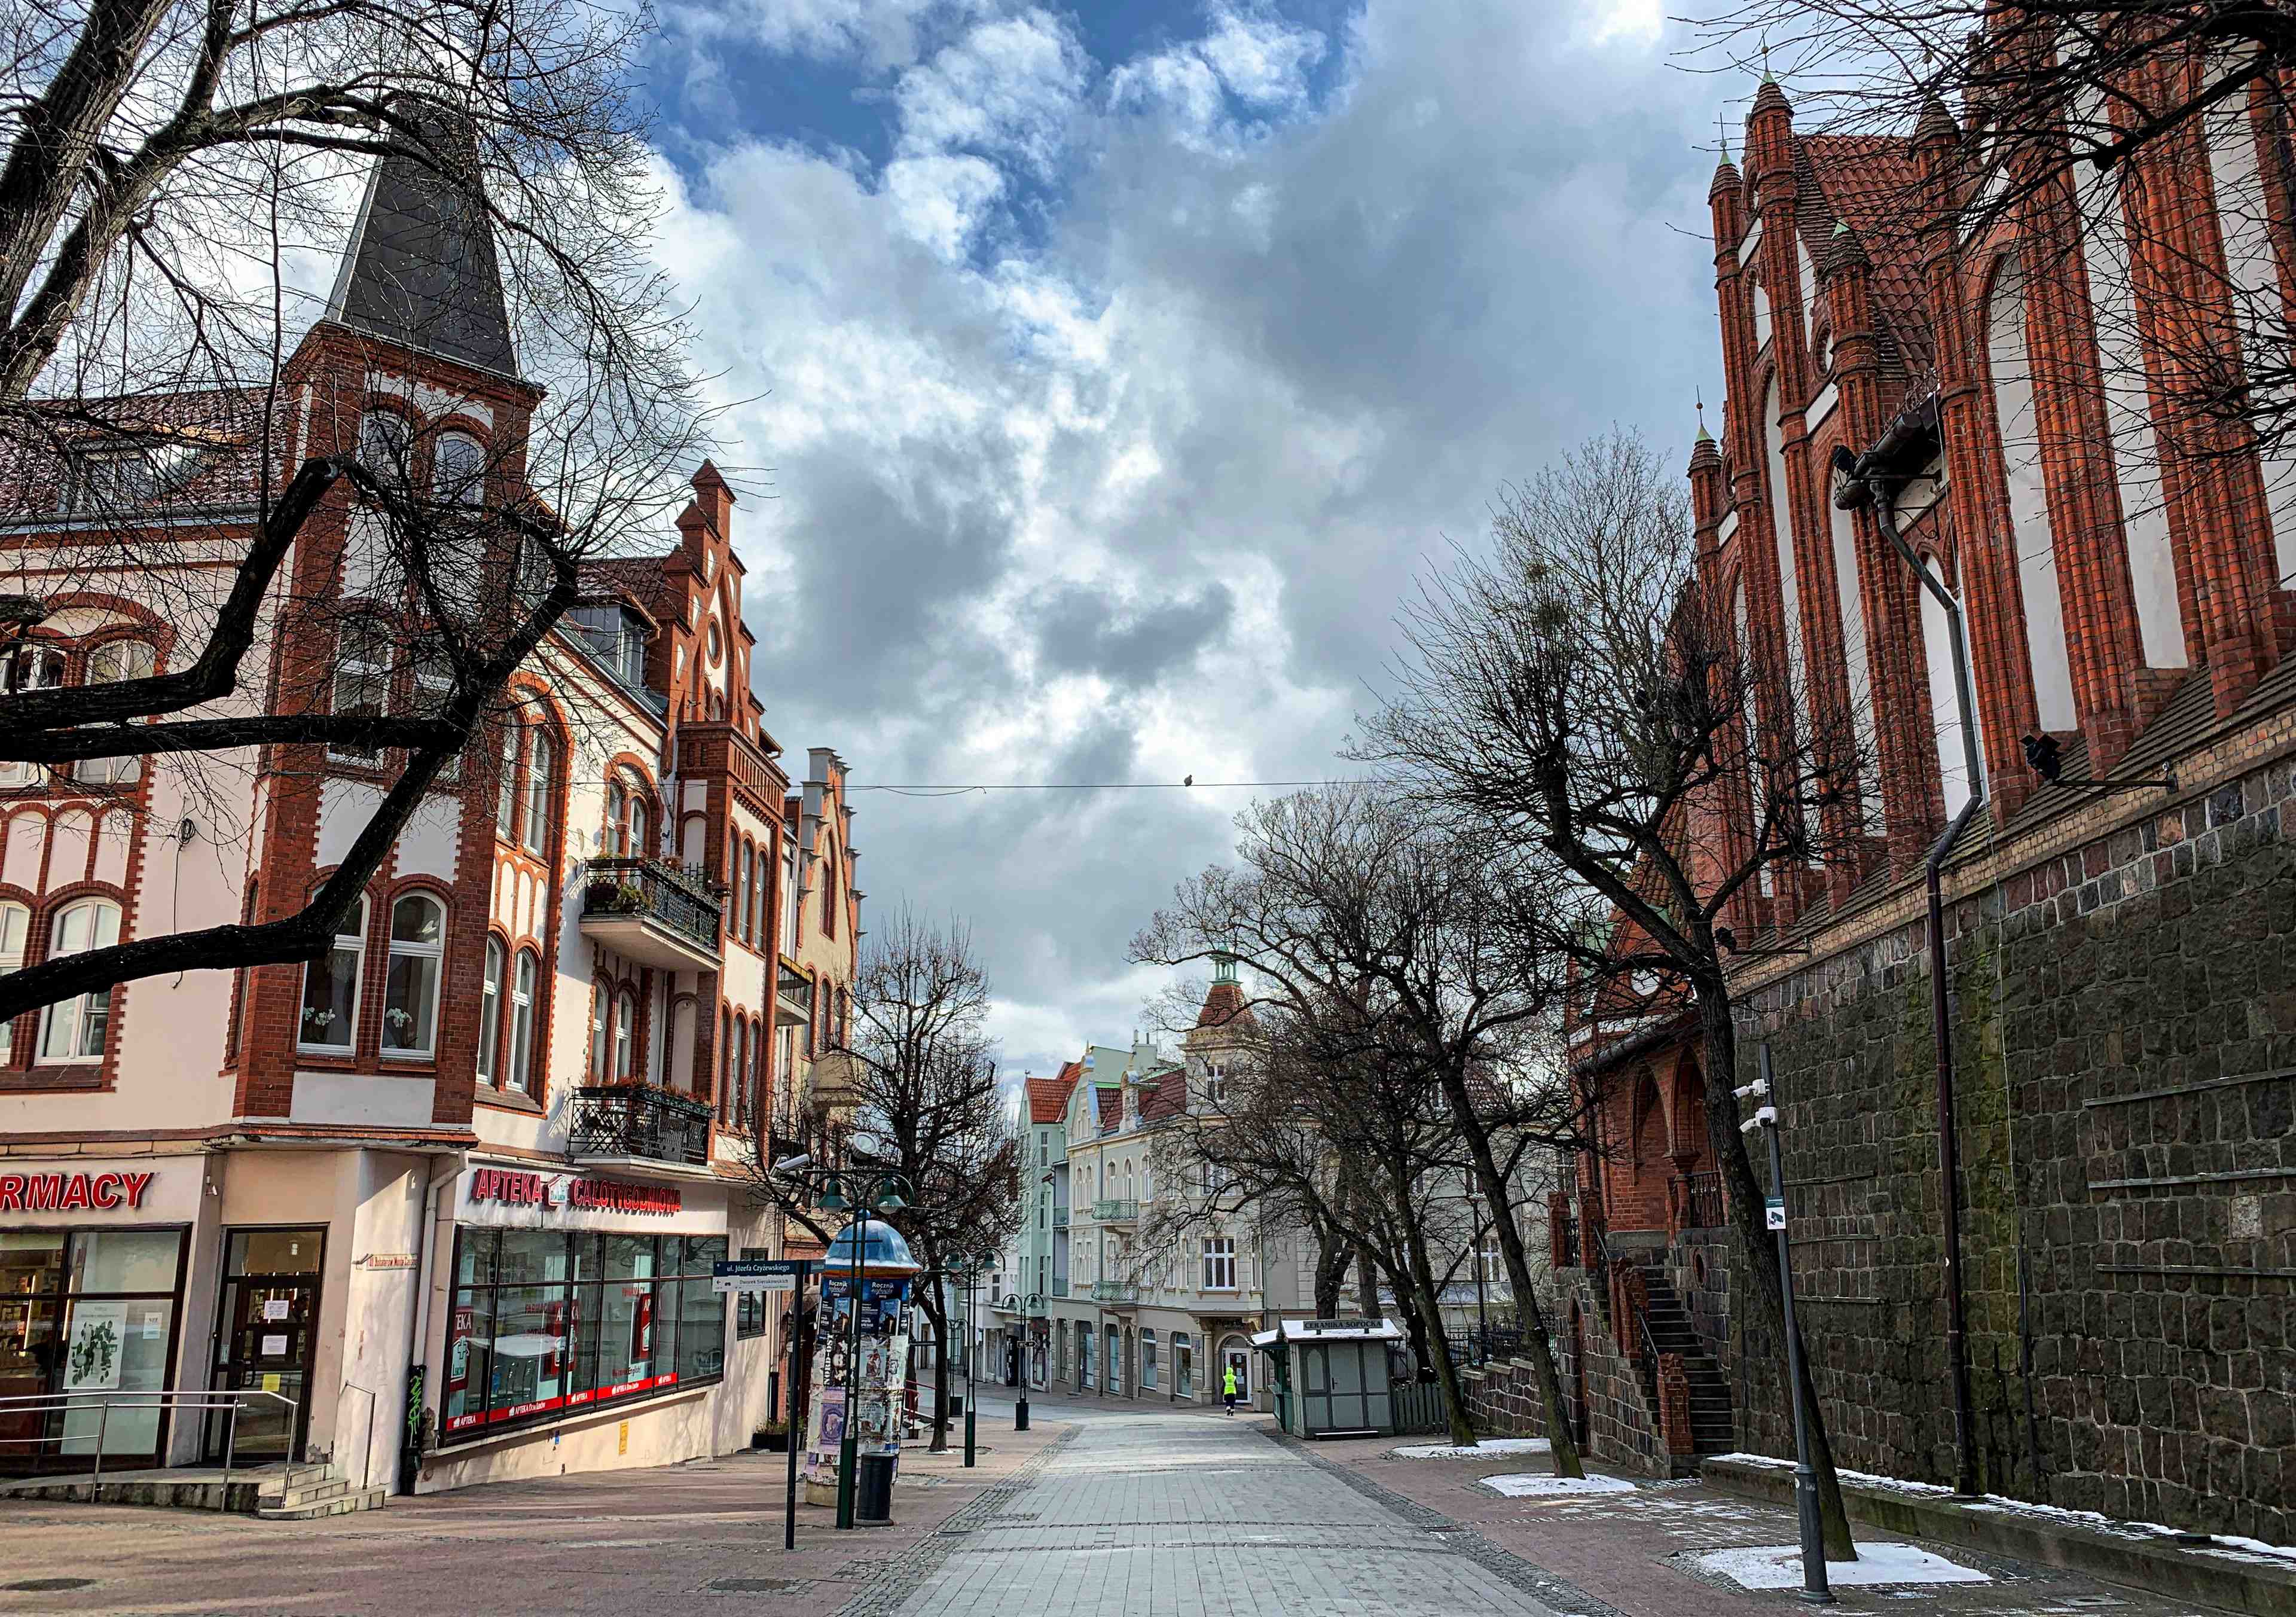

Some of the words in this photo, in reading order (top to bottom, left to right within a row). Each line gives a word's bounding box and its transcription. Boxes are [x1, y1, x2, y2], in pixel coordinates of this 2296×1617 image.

[0, 1172, 151, 1210] RMACY
[476, 1168, 542, 1203] APTEKA
[735, 1264, 752, 1273] Józefa
[753, 1263, 790, 1273] Czyżewskiego
[823, 1334, 833, 1386] NORD-OST
[460, 1415, 476, 1426] APTEKA
[515, 1405, 529, 1414] APTEKA
